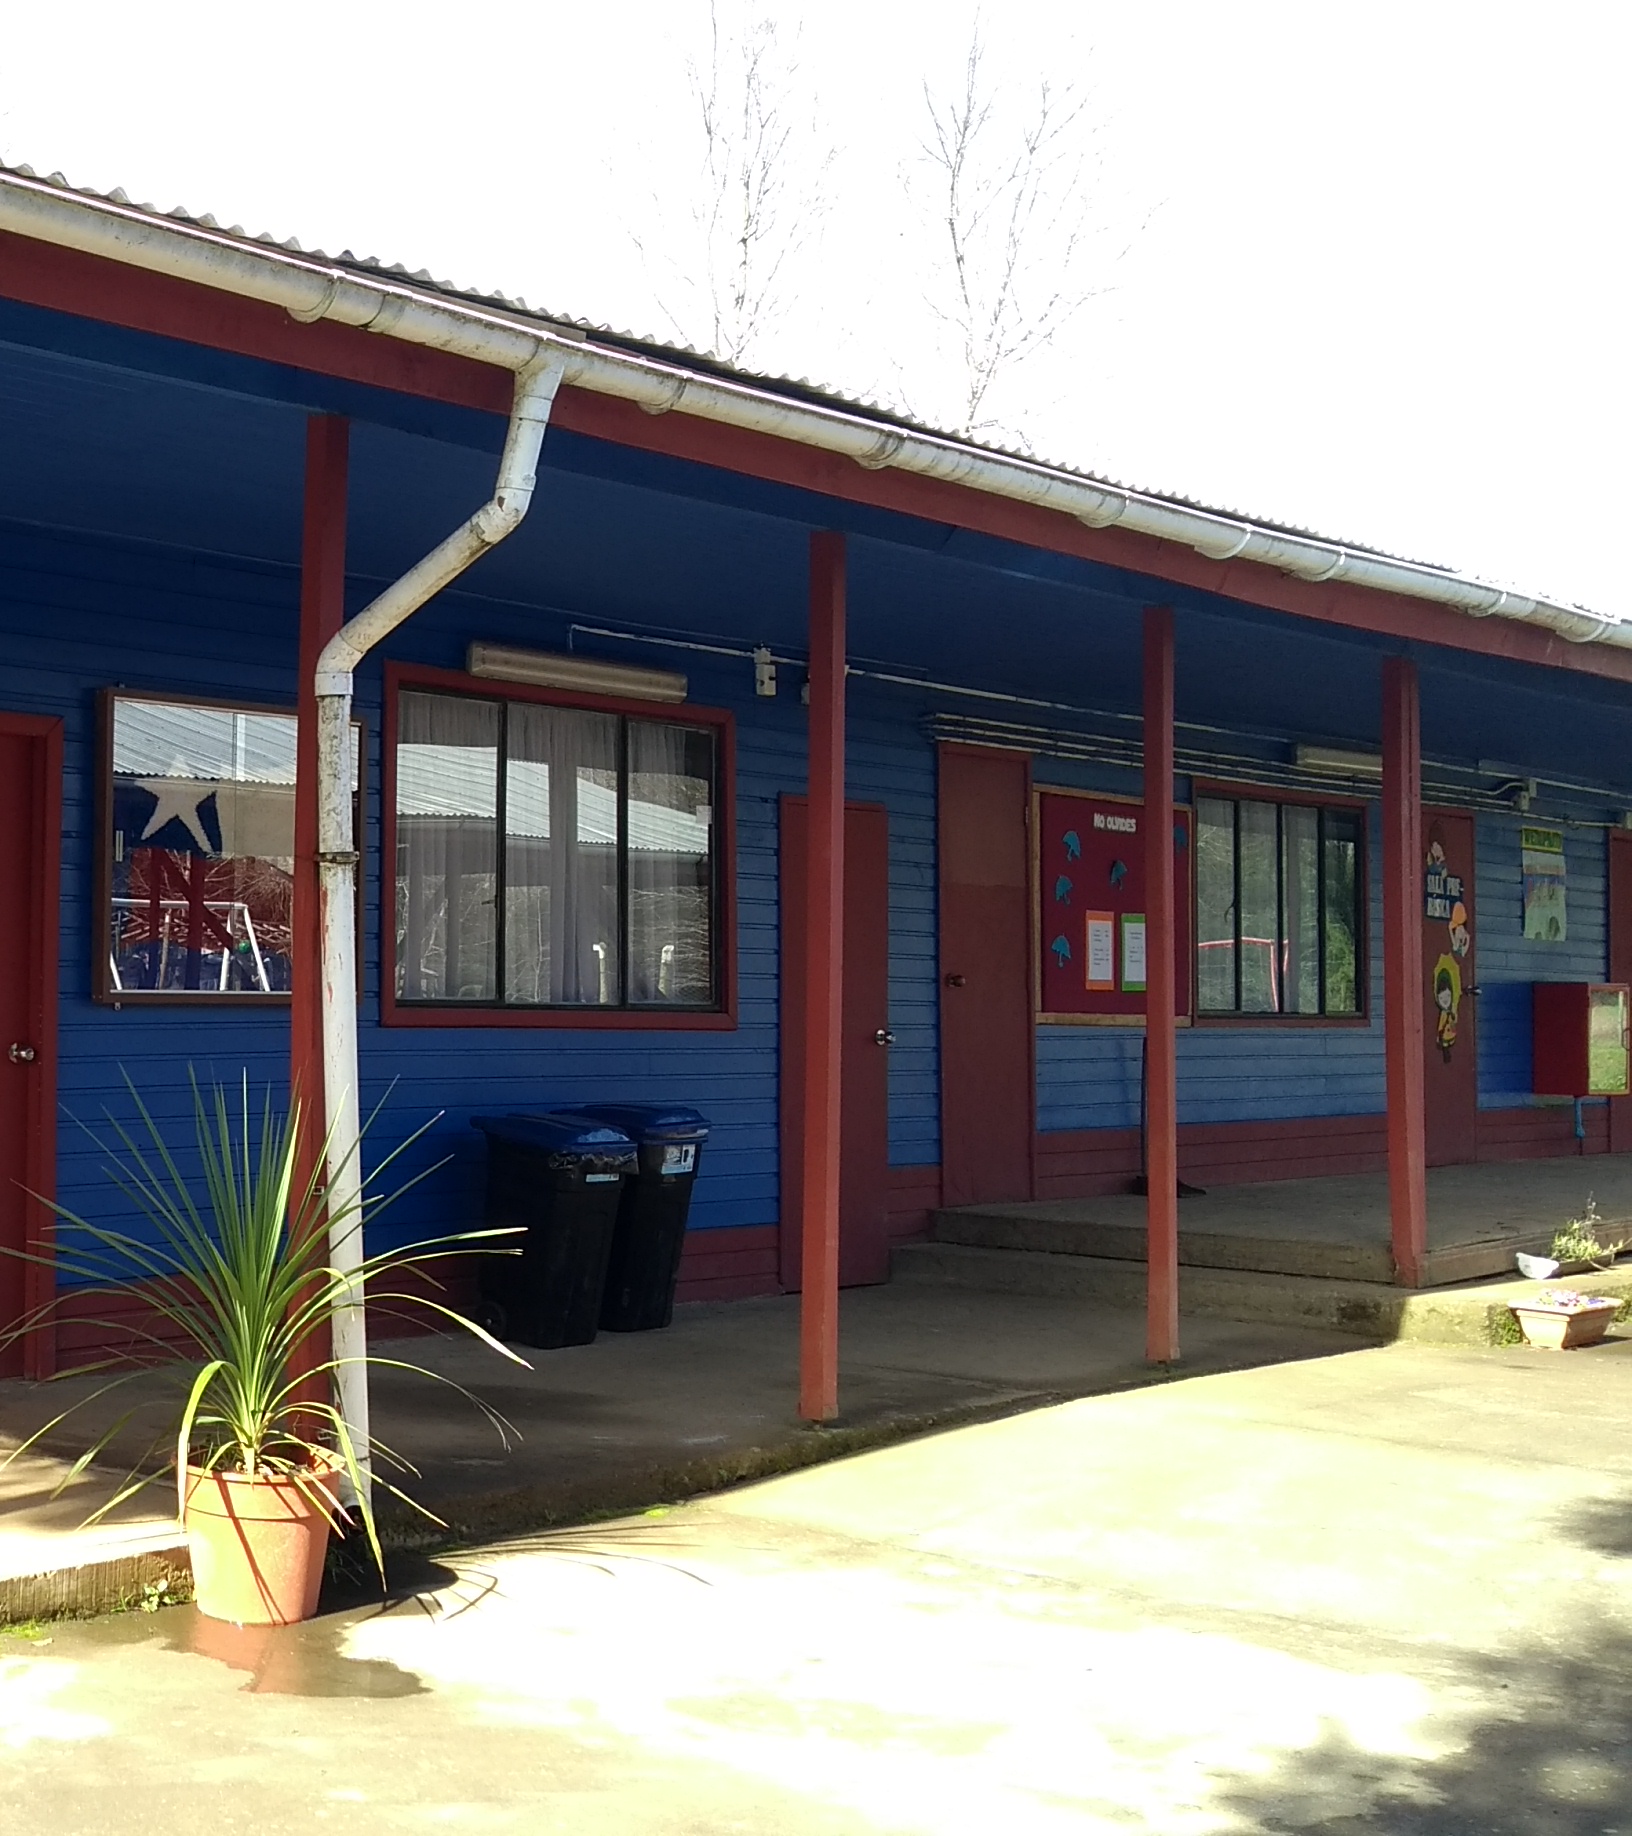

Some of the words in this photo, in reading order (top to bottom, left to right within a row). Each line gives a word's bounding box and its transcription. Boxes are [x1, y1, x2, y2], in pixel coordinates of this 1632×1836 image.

[1094, 813, 1105, 829] NO
[1107, 816, 1137, 832] OLVIDES
[1427, 873, 1445, 895] SALA
